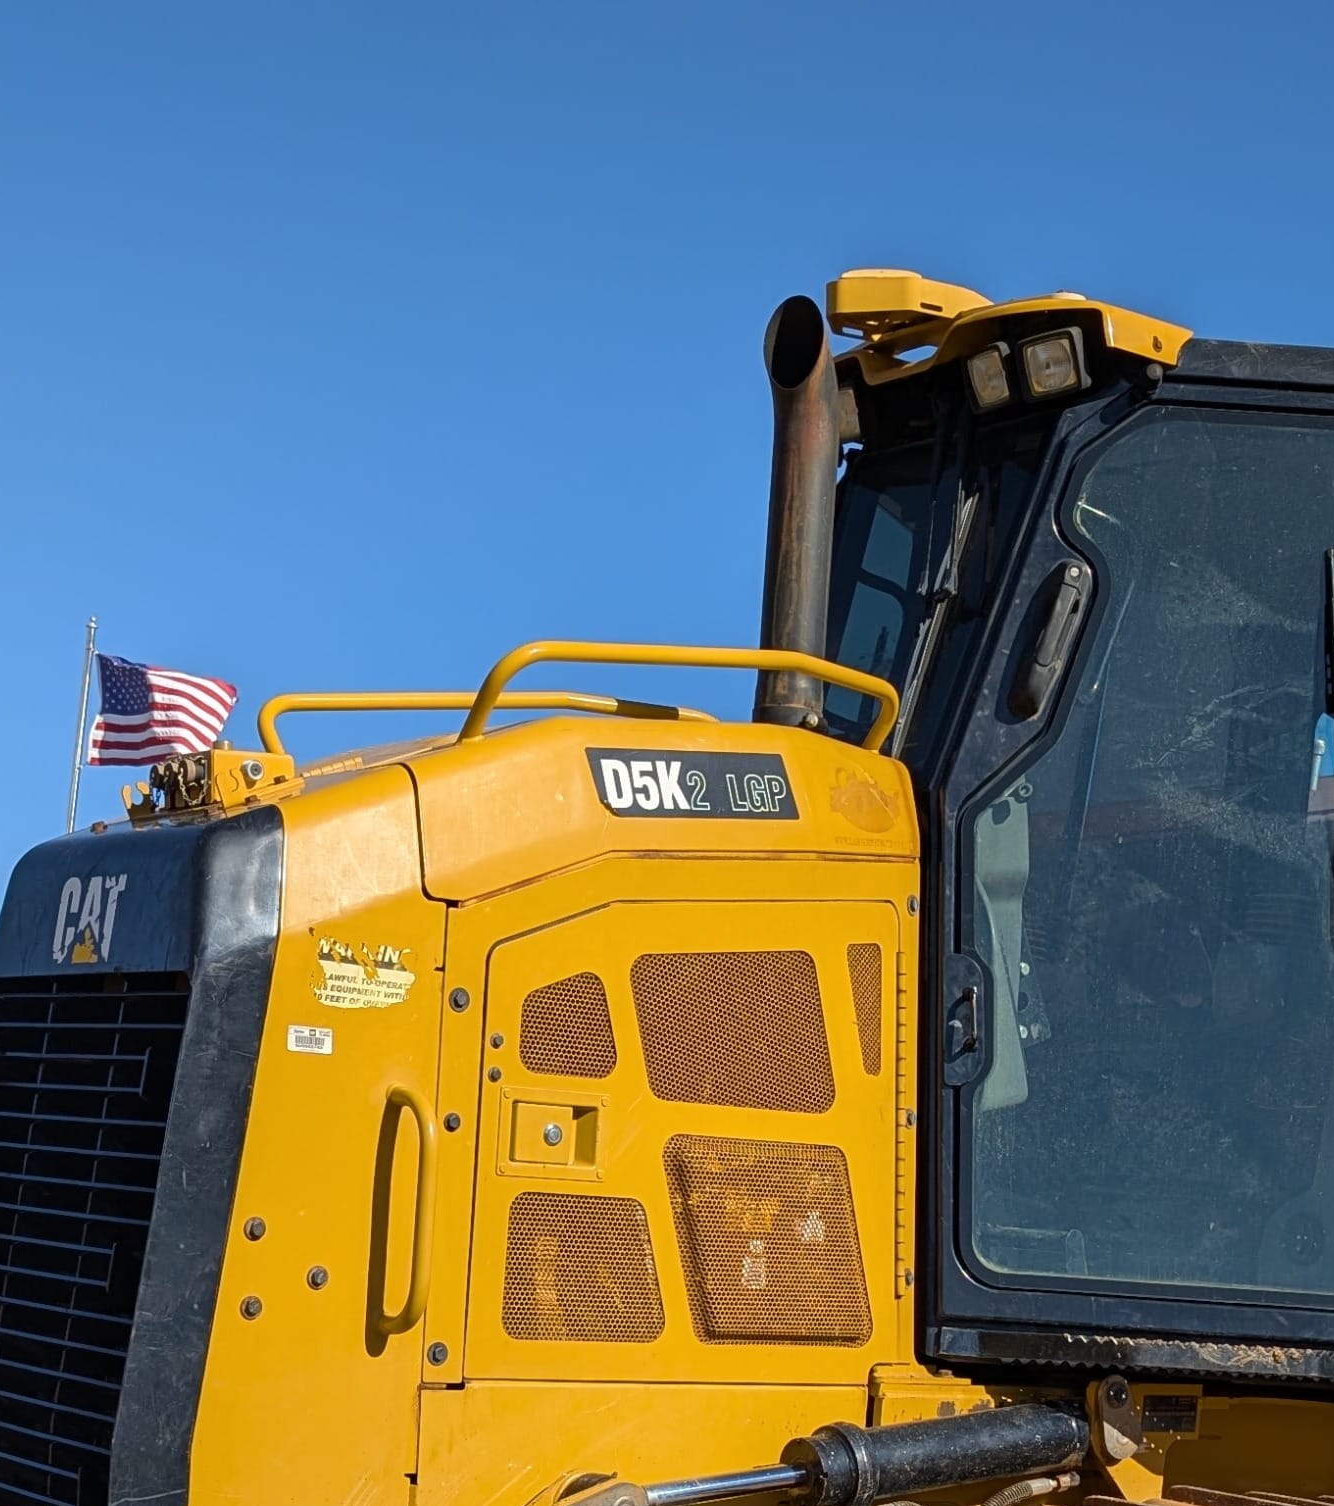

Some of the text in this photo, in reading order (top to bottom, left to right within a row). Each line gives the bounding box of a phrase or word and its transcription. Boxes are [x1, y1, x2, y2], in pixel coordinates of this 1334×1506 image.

[600, 759, 787, 812] D5K2 LGP
[52, 874, 128, 964] CAT
[324, 994, 347, 1004] FEET
